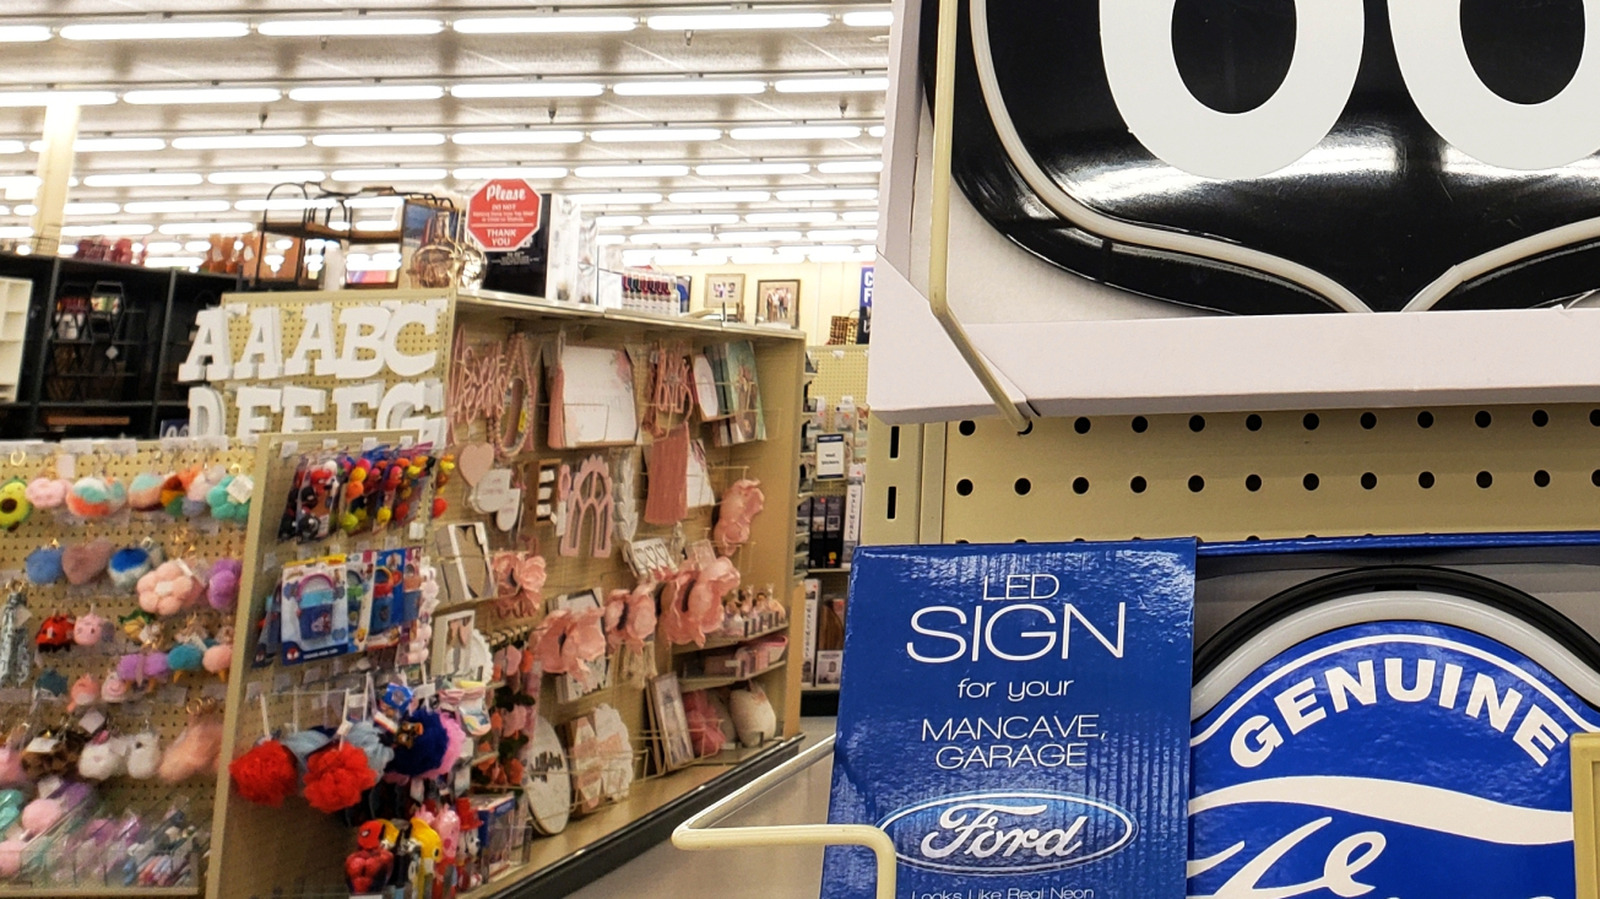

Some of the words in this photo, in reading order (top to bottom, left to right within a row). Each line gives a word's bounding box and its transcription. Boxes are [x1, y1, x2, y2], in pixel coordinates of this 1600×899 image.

[486, 184, 526, 201] Please
[487, 229, 517, 238] THANK
[492, 237, 511, 246] YOU
[983, 573, 1060, 601] LED
[906, 602, 1126, 663] SIGN
[957, 678, 997, 699] for
[1007, 679, 1075, 702] your
[1229, 657, 1569, 768] GENUINE
[922, 714, 1106, 742] MANCAVE,
[935, 743, 1089, 770] GARAGE
[920, 802, 1089, 859] Ford
[968, 888, 1002, 899] Like
[1007, 887, 1045, 899] Real
[1050, 887, 1095, 899] Neon
